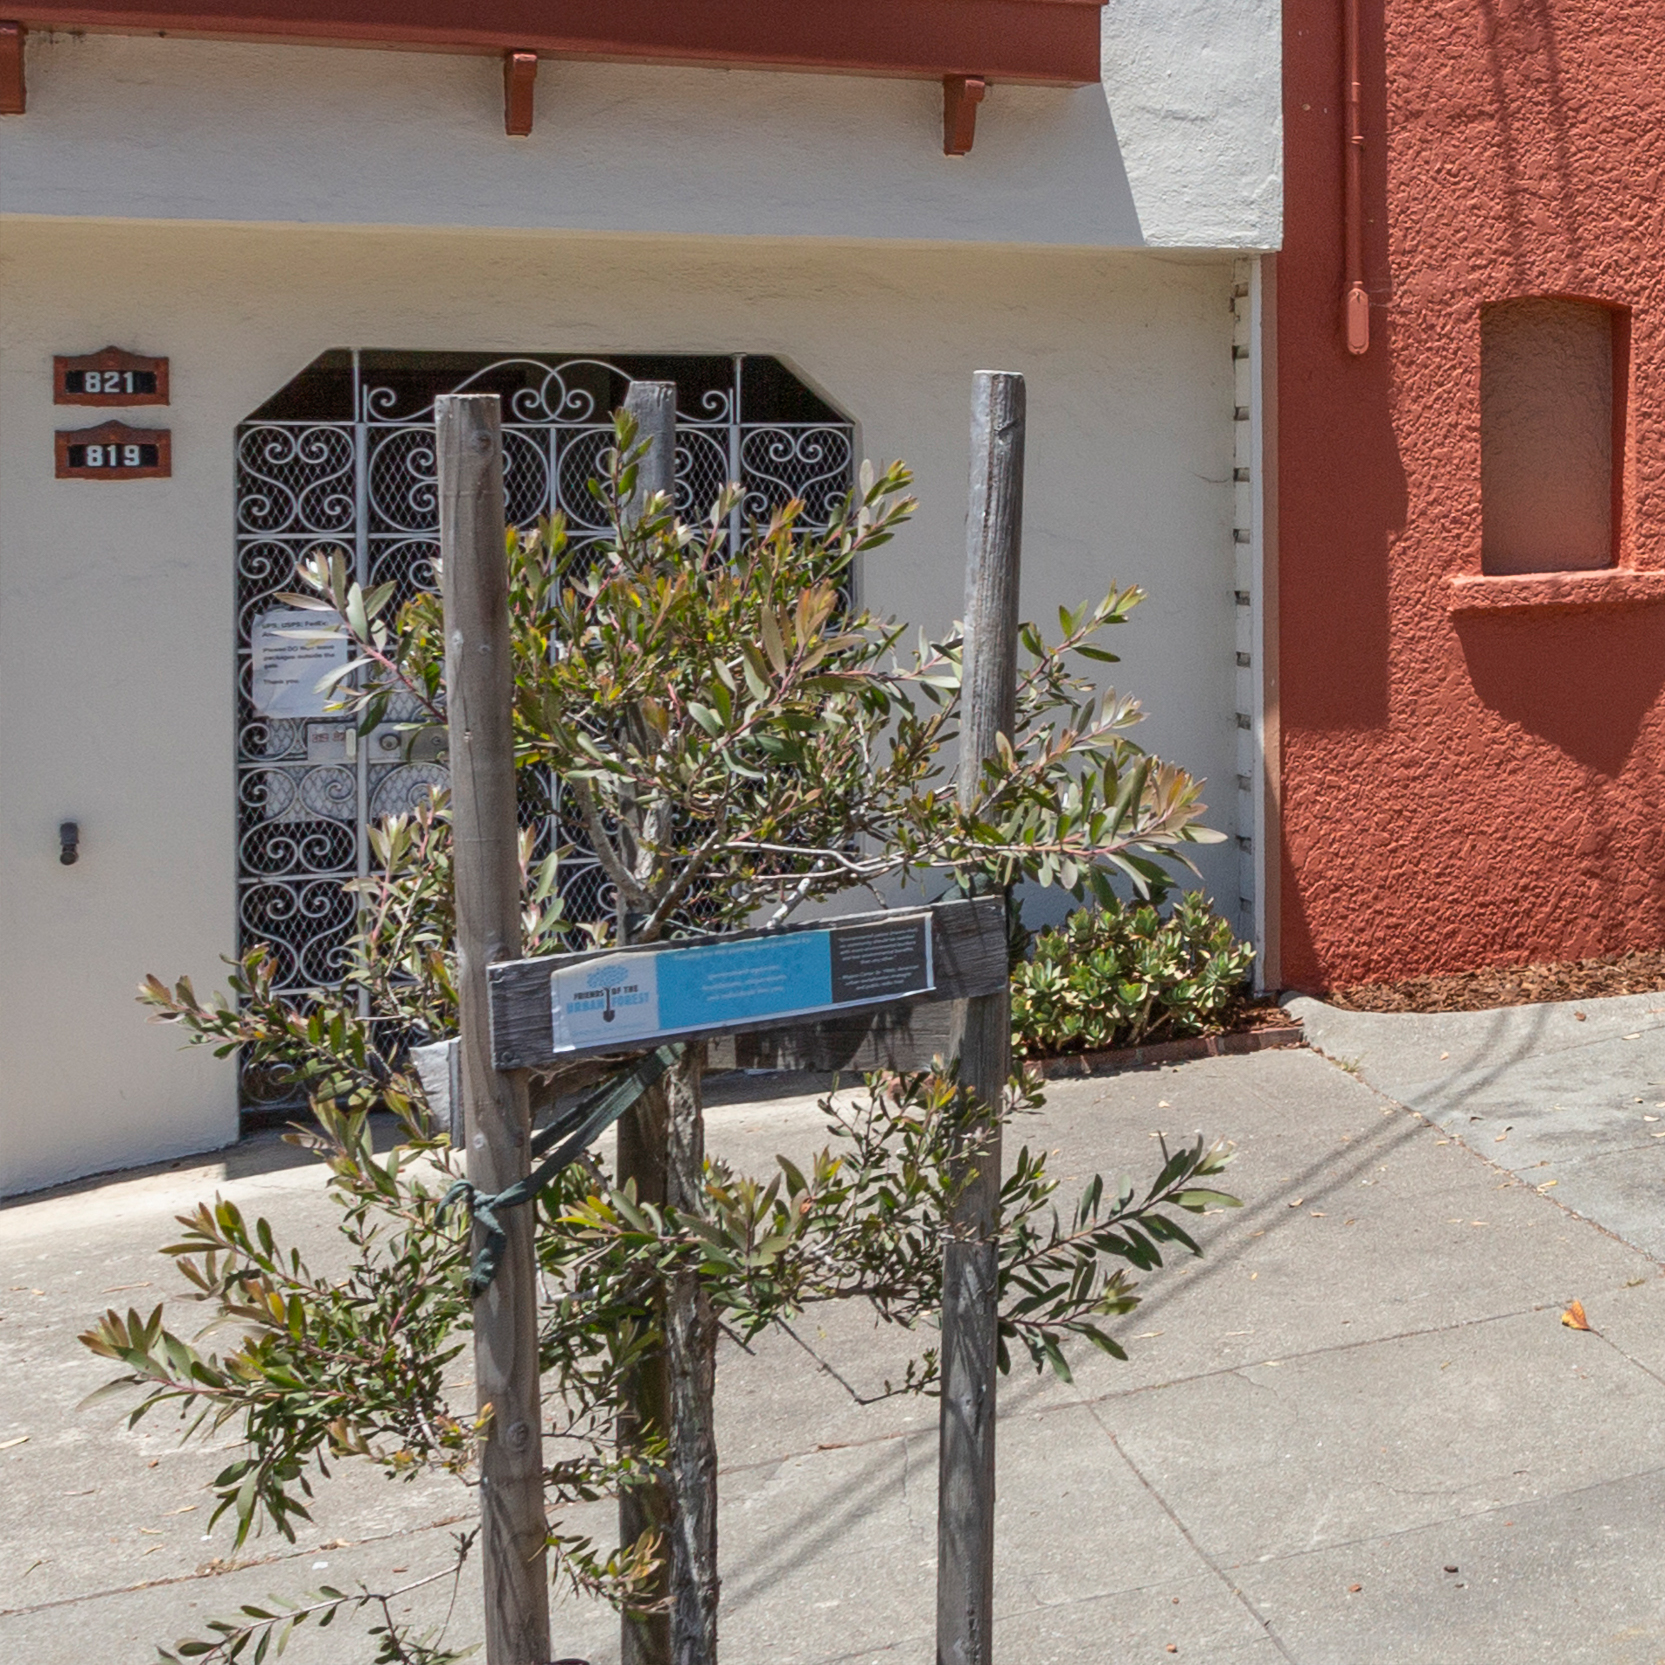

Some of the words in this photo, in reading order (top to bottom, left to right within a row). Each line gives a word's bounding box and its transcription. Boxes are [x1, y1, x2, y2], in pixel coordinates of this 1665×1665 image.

[85, 371, 134, 393] 821
[86, 444, 141, 467] 819
[566, 997, 605, 1014] URBAN
[612, 992, 650, 1007] FOREST
[573, 989, 604, 1000] FRIENDS
[611, 986, 621, 995] OF
[623, 984, 638, 993] THE
